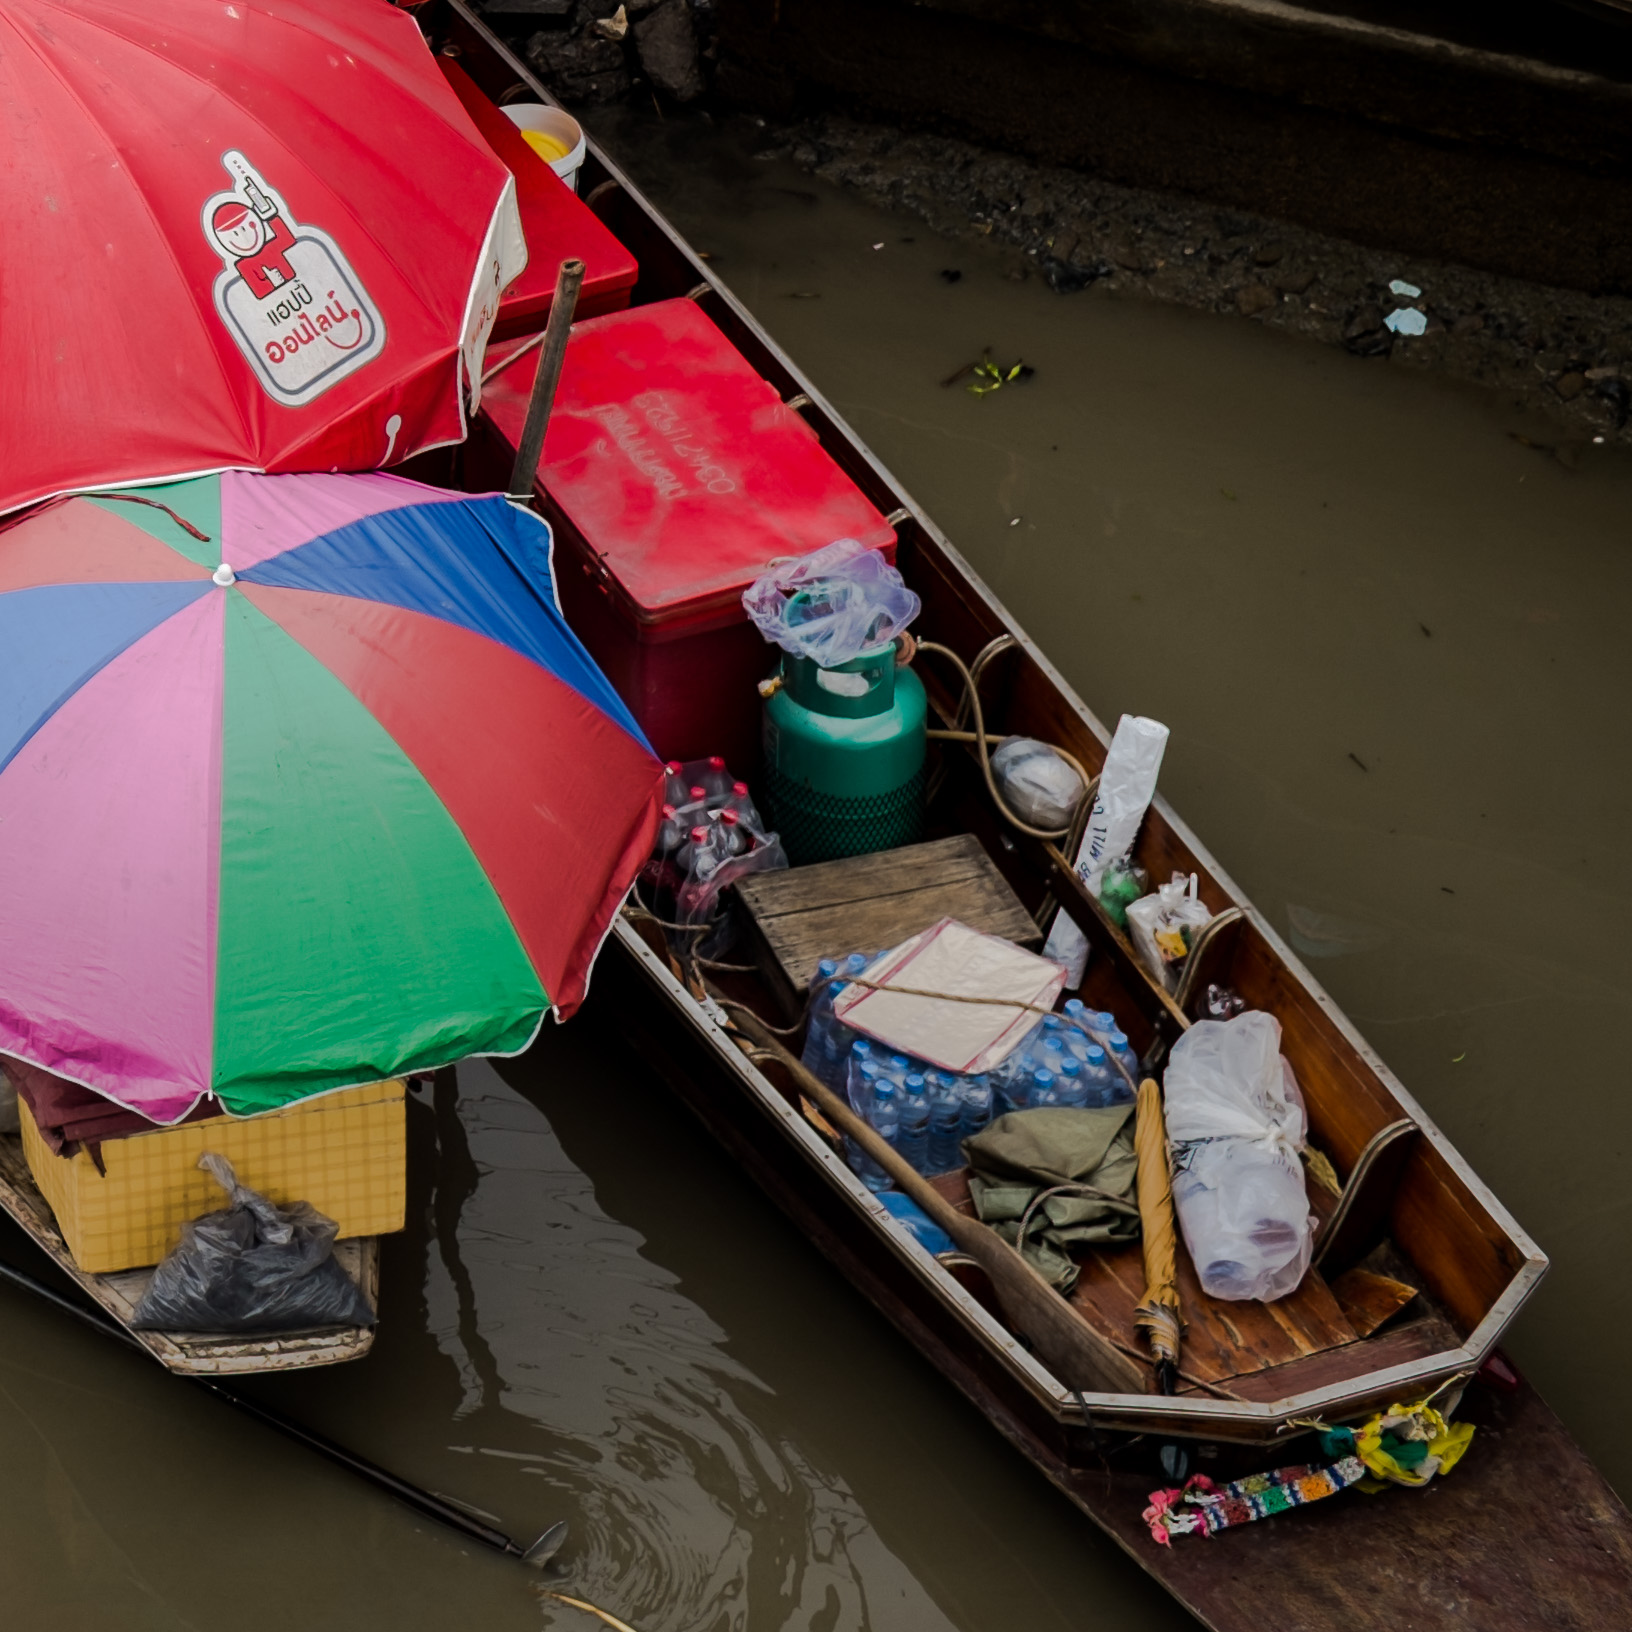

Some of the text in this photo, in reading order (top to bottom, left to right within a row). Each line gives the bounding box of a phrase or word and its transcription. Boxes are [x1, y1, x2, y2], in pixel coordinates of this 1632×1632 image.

[265, 289, 349, 364] ออนไลน์
[266, 279, 313, 326] แฮปปี้
